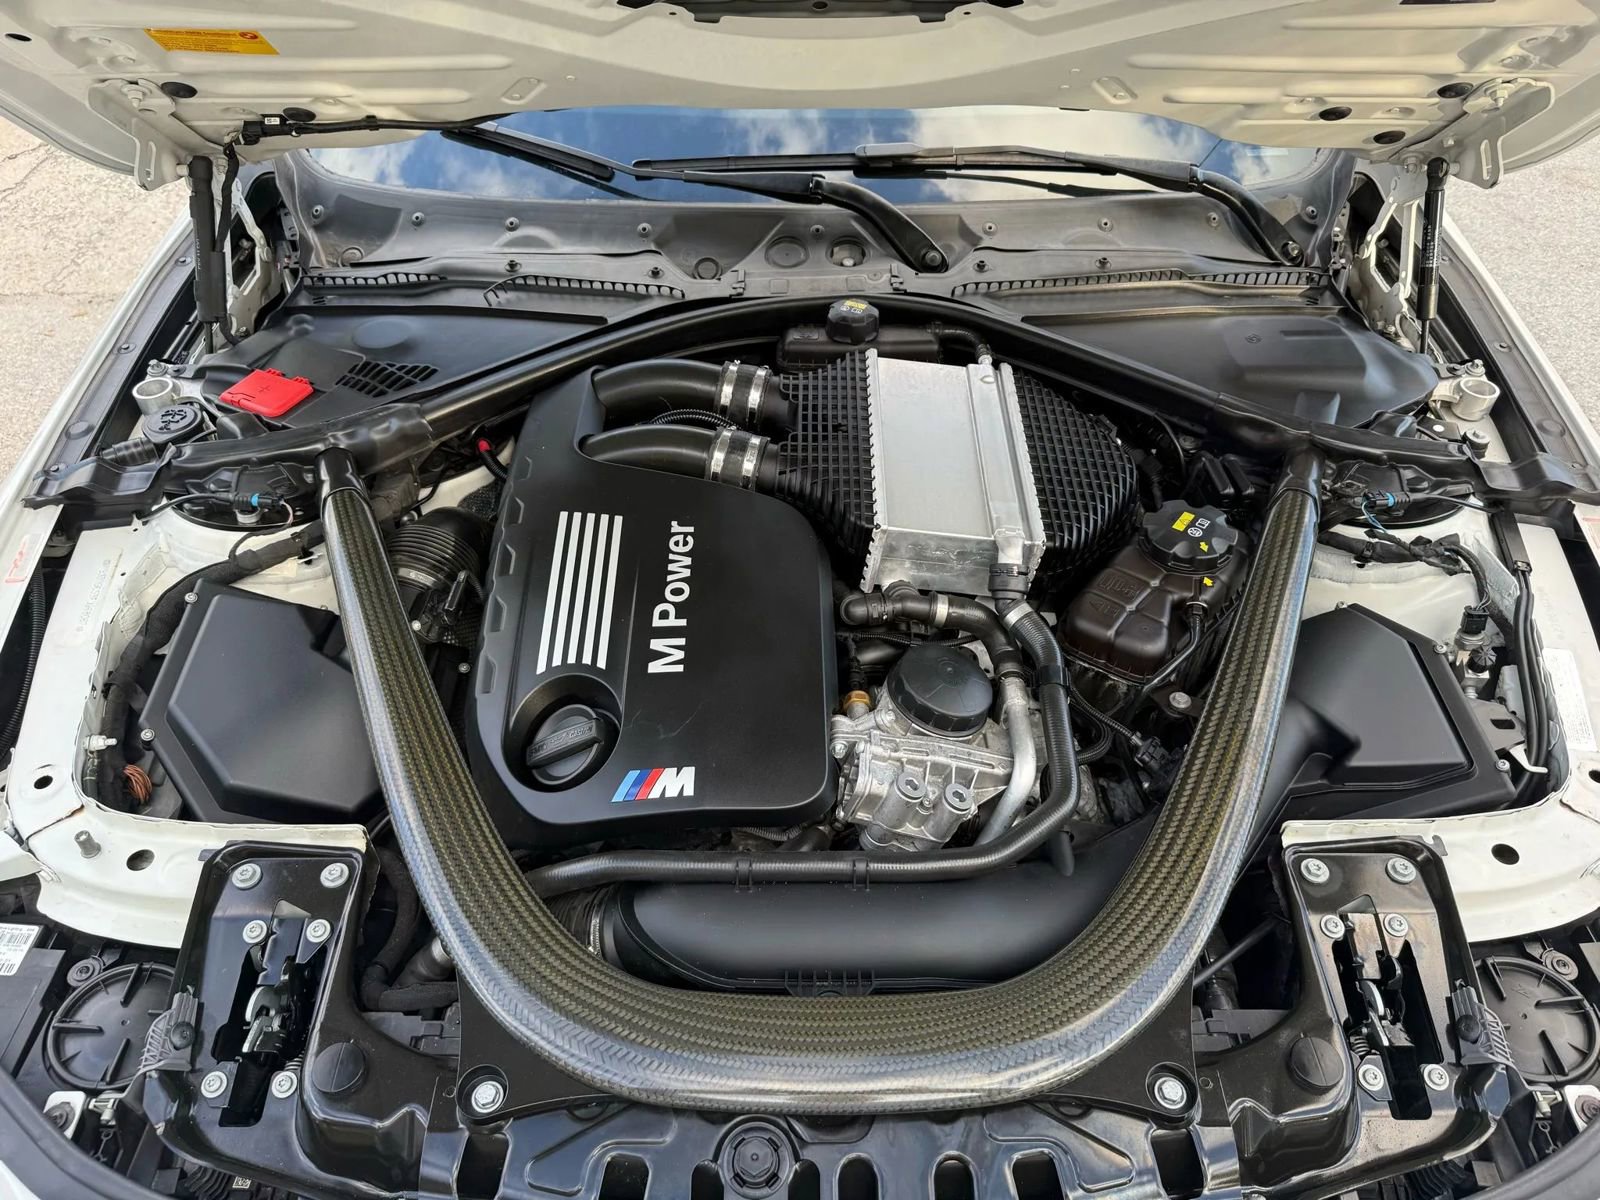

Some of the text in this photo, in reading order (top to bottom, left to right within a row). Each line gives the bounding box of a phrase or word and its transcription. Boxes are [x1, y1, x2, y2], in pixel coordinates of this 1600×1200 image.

[647, 520, 695, 673] M Power
[647, 766, 696, 799] M
